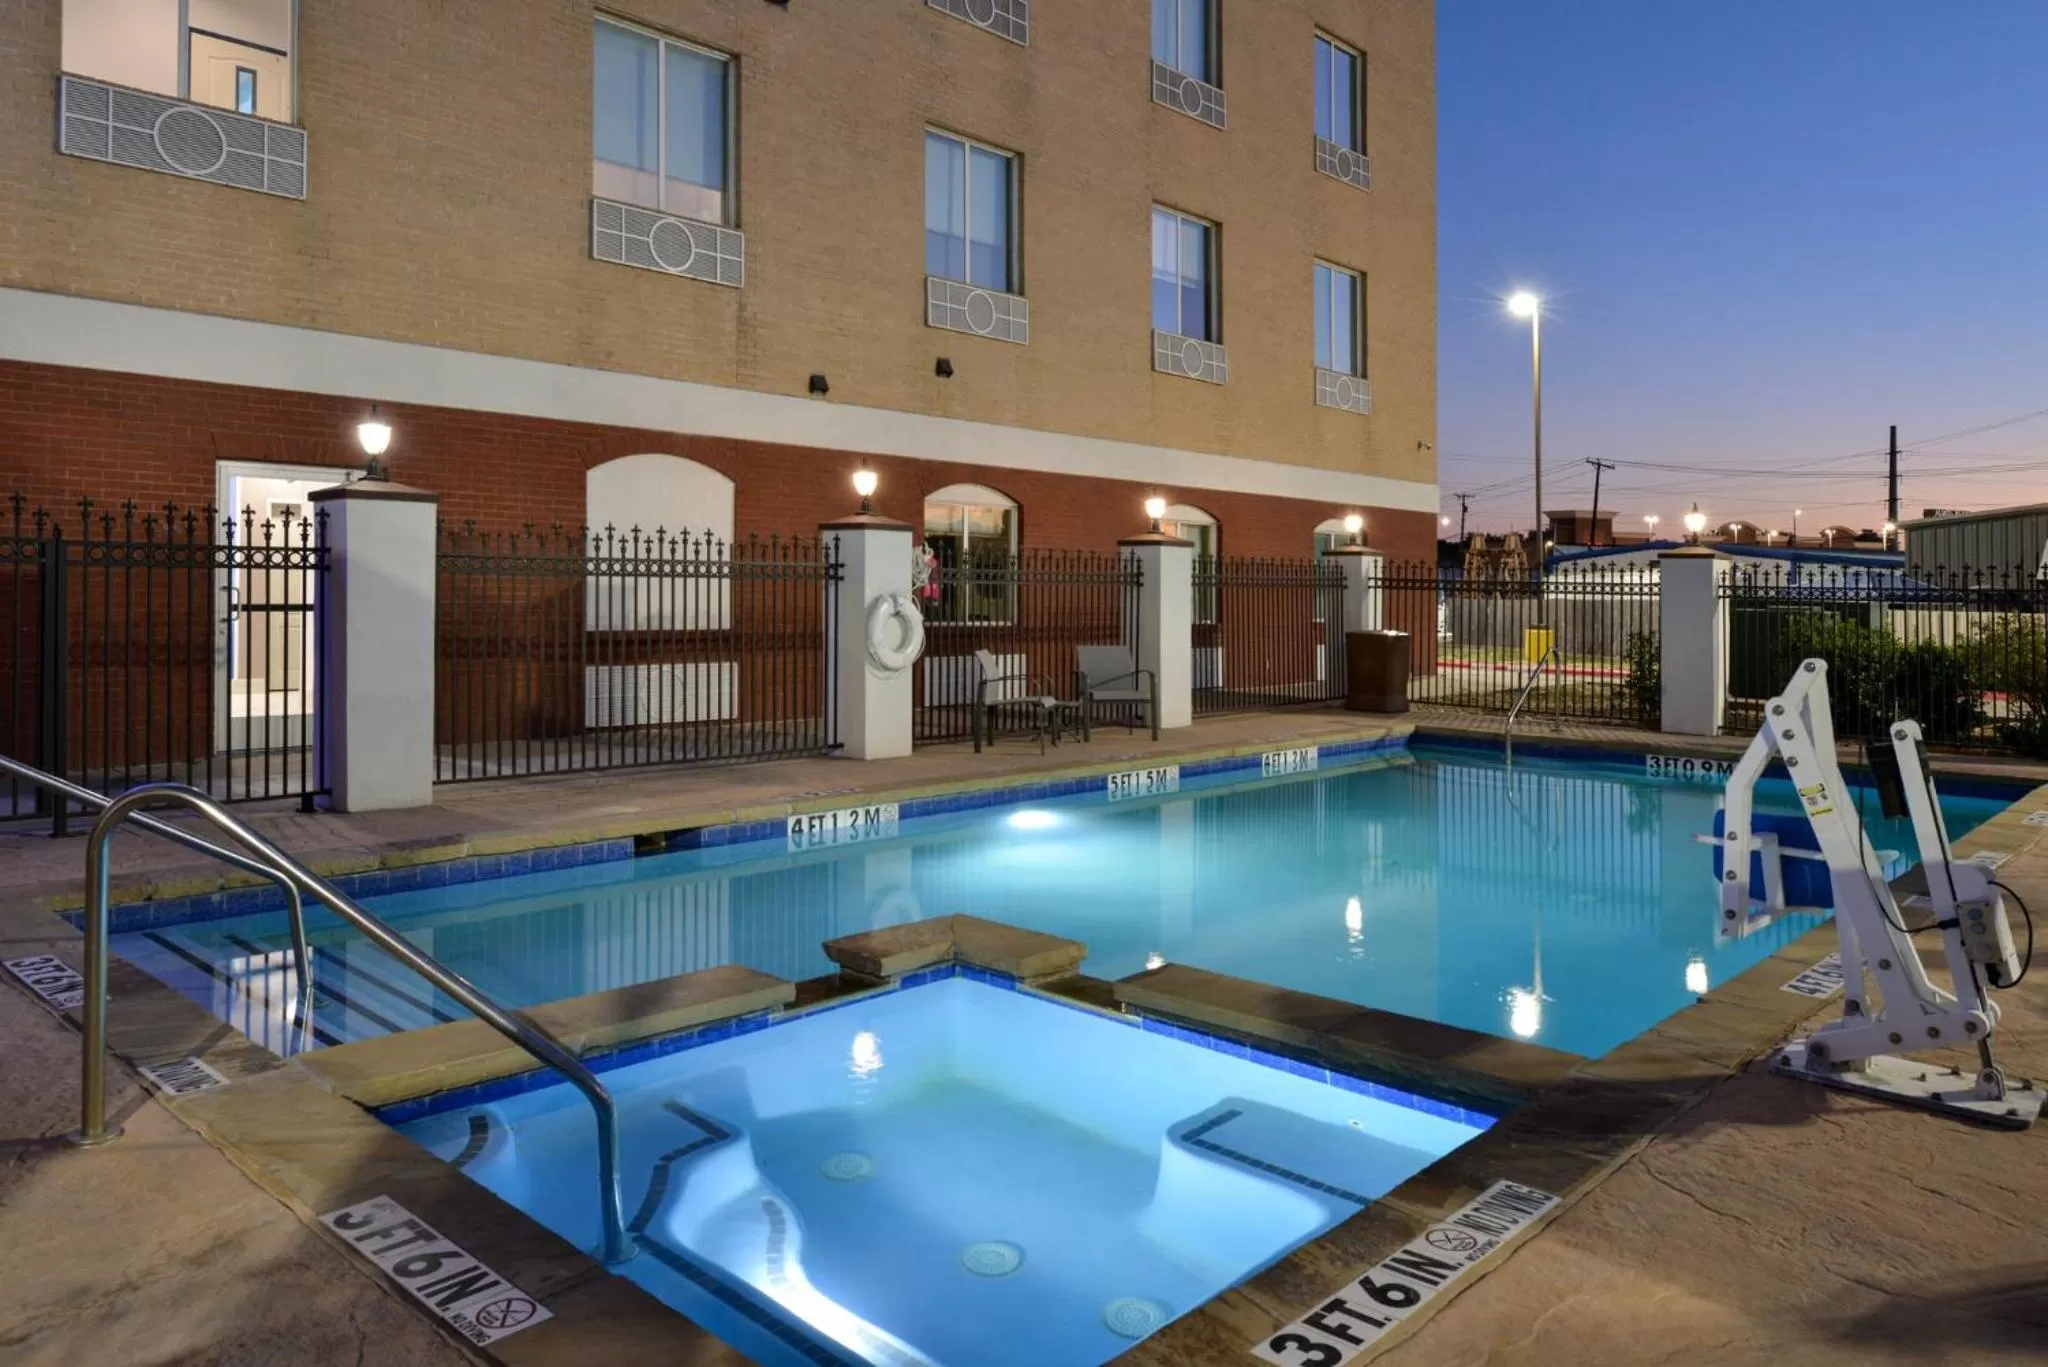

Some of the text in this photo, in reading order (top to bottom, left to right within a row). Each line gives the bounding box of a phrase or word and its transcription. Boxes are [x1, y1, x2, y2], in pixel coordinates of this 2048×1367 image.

[391, 1250, 466, 1279] 6
[1380, 1249, 1465, 1287] IN.
[1358, 1275, 1421, 1309] 6
[1269, 1333, 1343, 1367] 3
